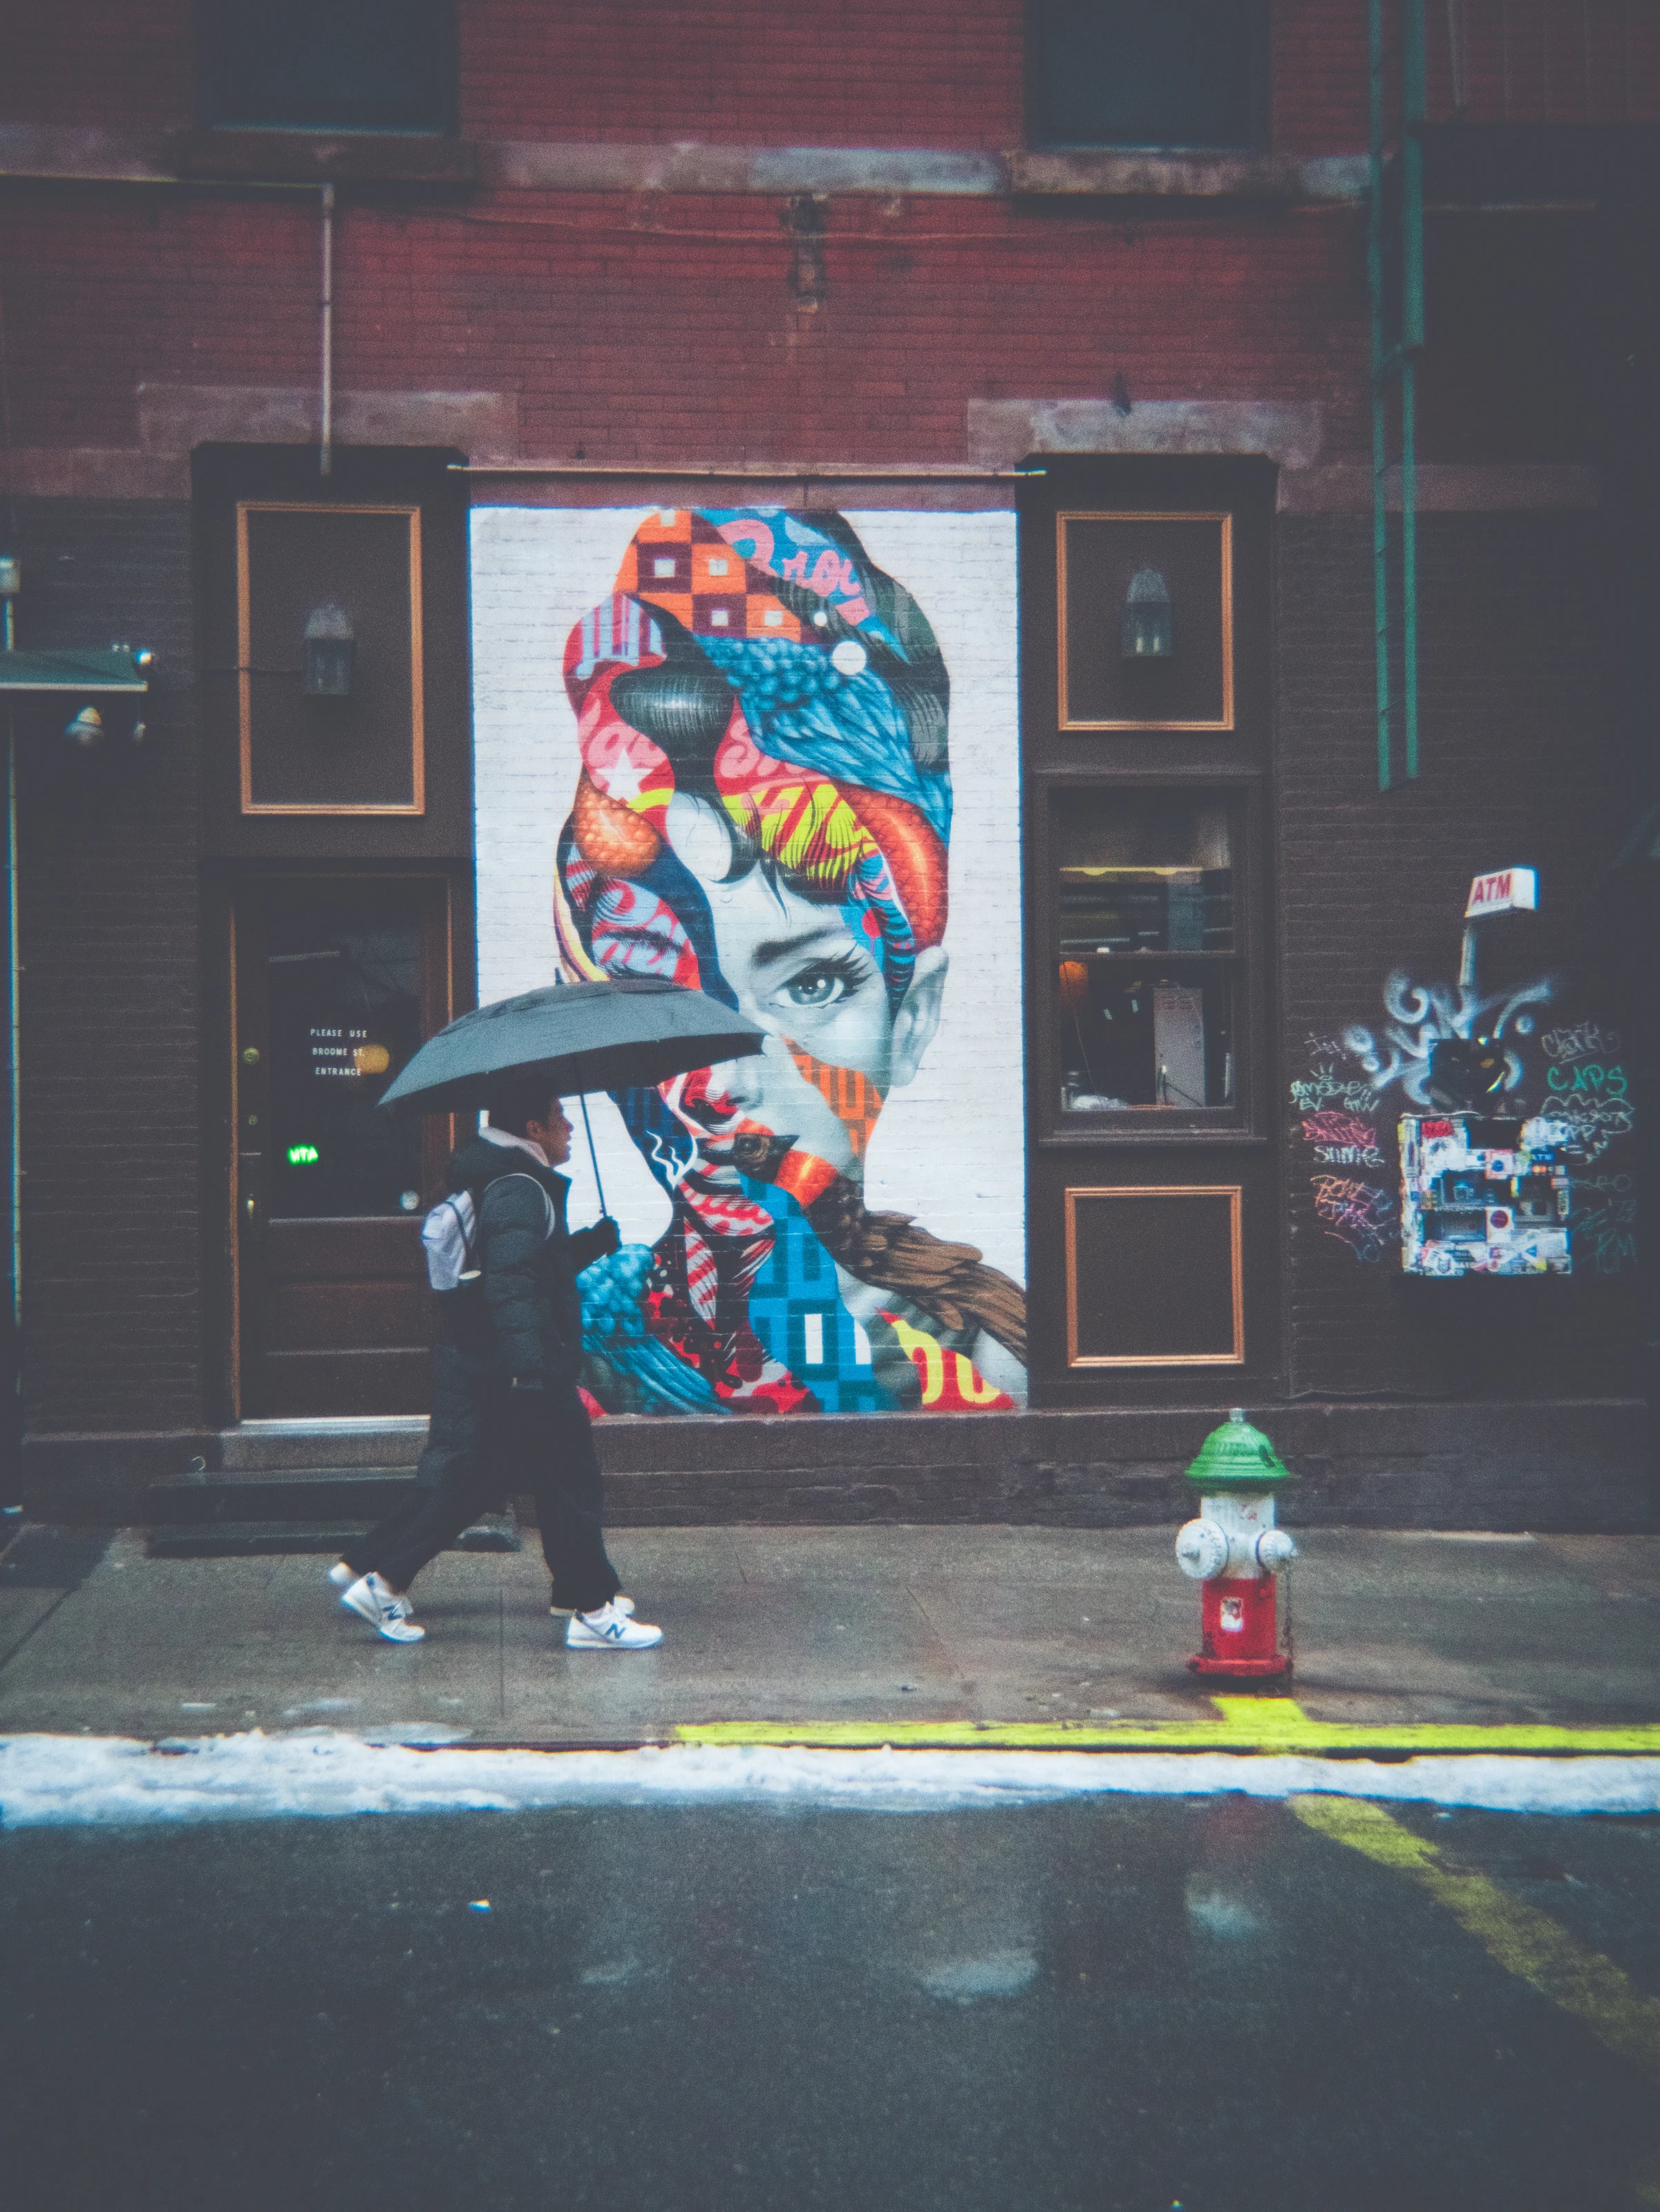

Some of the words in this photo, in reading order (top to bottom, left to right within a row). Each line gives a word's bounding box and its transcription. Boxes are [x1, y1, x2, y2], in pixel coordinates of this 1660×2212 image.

[1473, 873, 1511, 903] ATM
[310, 1029, 342, 1038] PLEASE
[312, 1047, 348, 1056] BROOME
[315, 1067, 361, 1076] ENTRANCE
[605, 1623, 626, 1639] N
